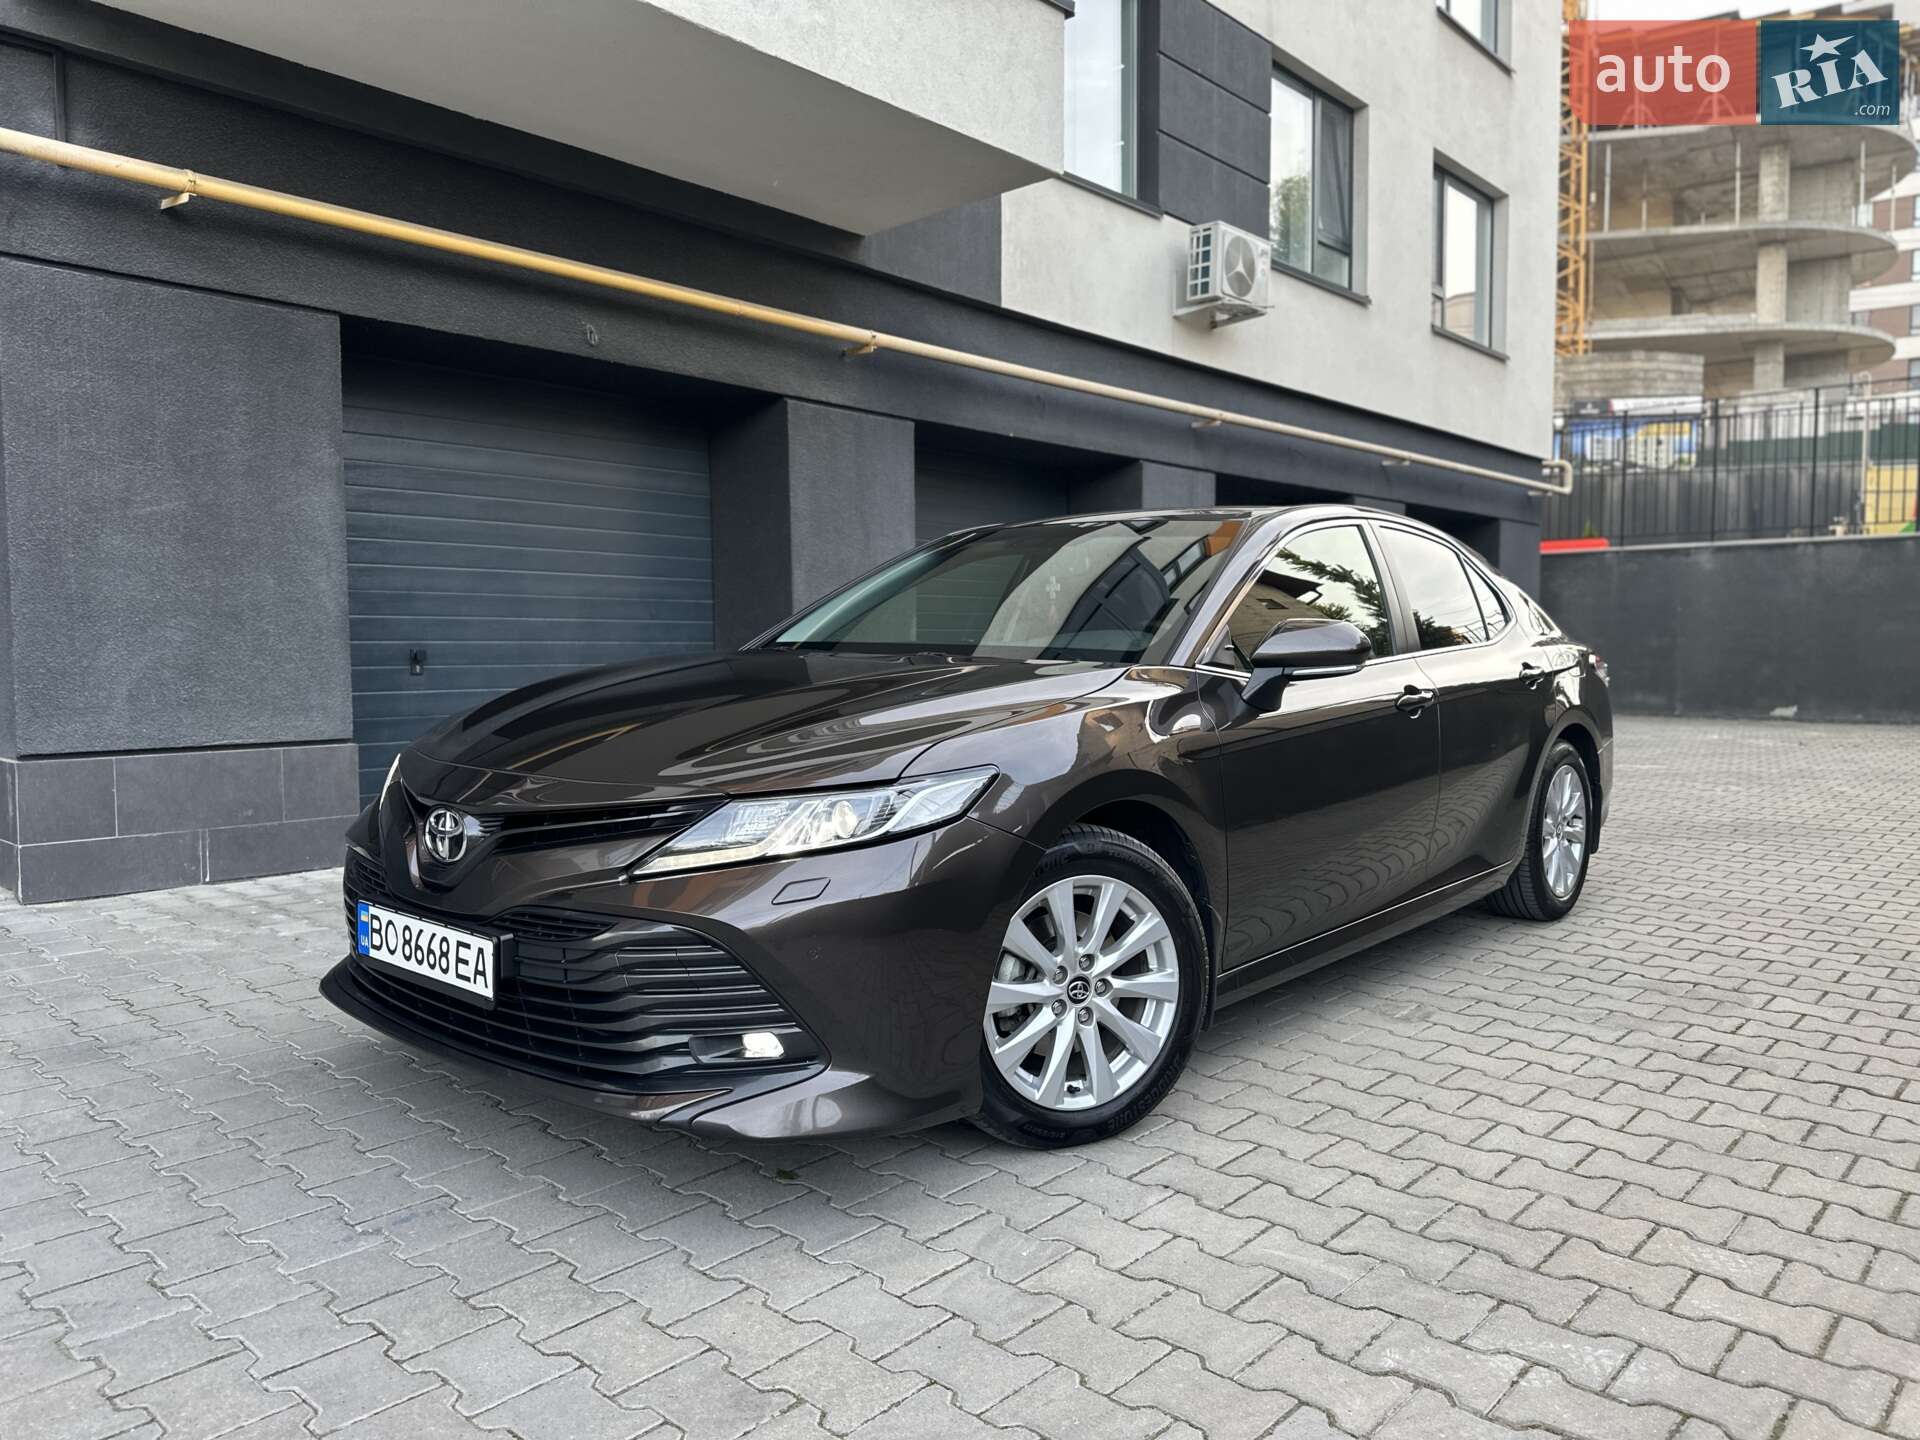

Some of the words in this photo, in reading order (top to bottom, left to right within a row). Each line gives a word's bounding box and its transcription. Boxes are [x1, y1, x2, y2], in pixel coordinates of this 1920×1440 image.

[361, 935, 369, 946] UA
[370, 914, 399, 956] BO
[402, 924, 450, 975] 8668
[455, 940, 489, 989] EA
